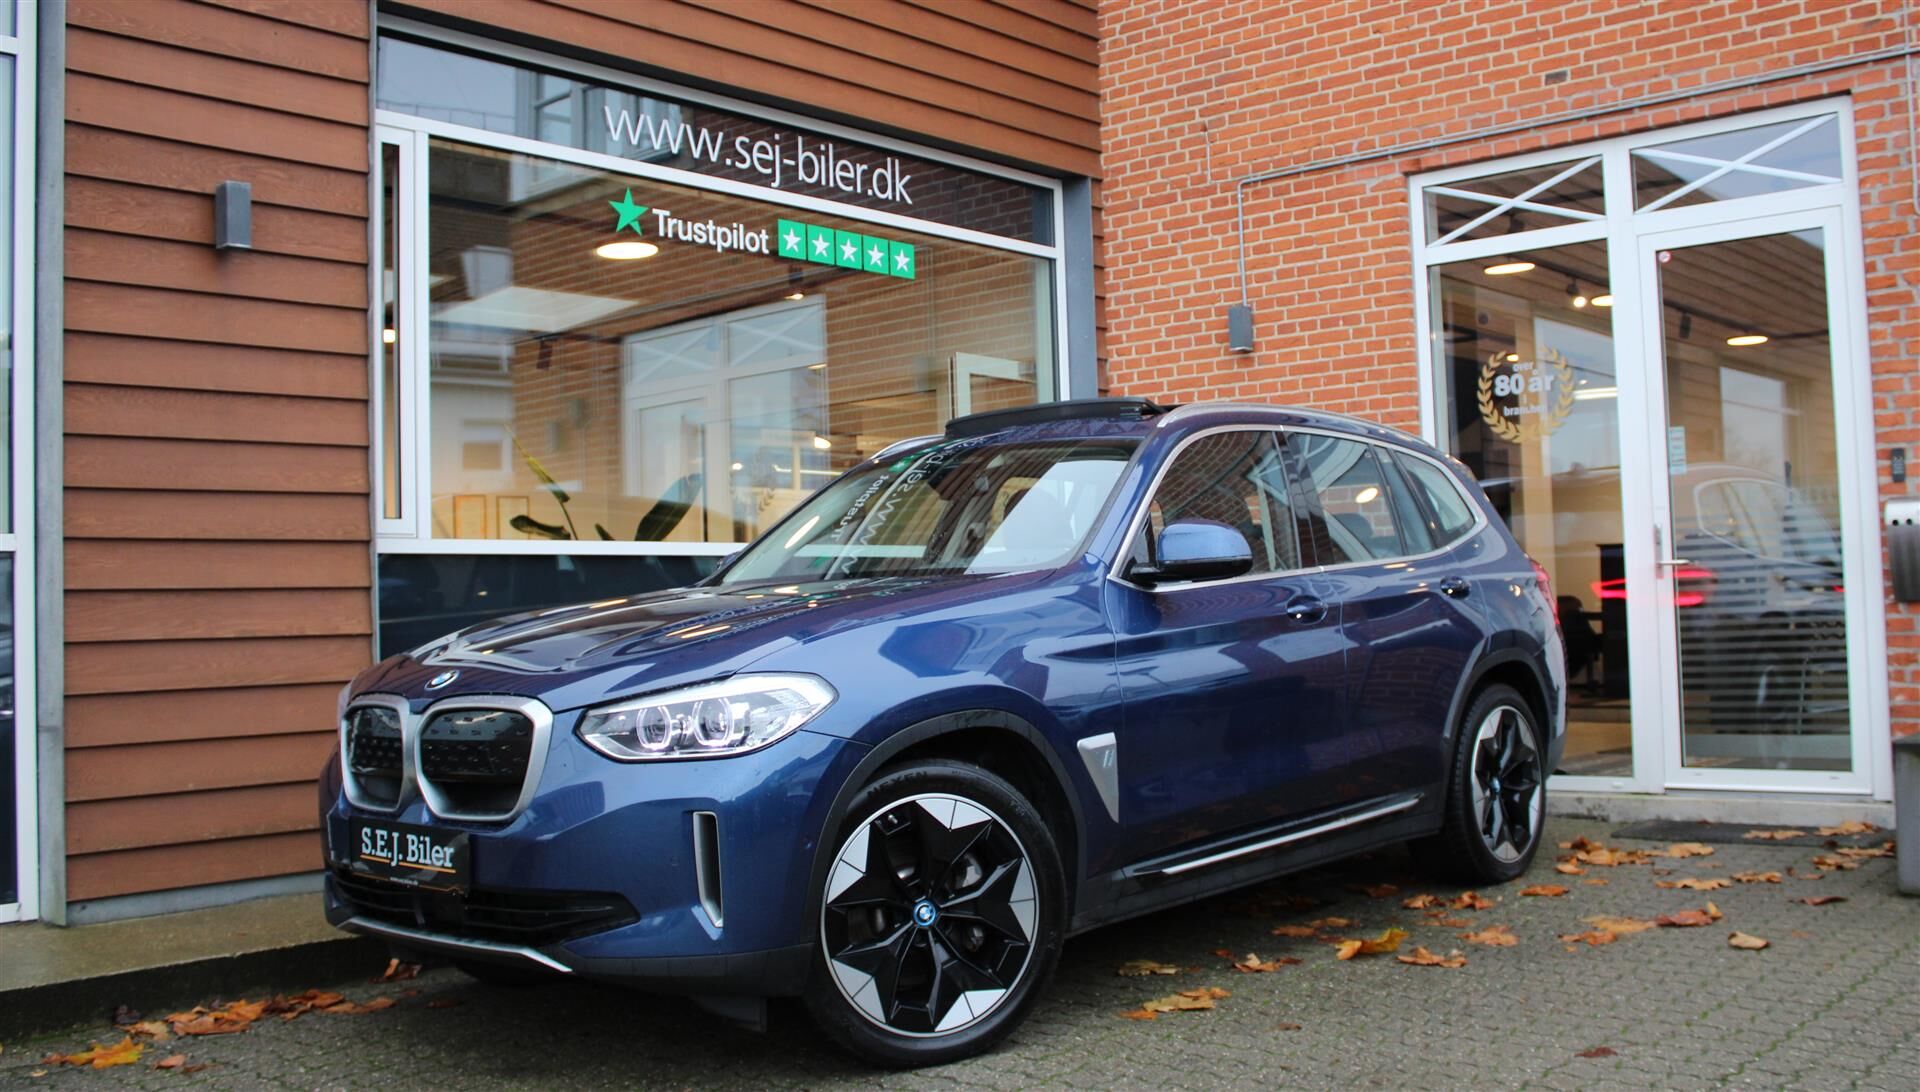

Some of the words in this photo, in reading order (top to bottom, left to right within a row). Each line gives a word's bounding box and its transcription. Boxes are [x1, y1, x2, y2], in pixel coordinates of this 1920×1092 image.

[604, 105, 913, 205] www.sej-biler.dk
[652, 208, 769, 254] Trustpilot
[1494, 373, 1524, 397] 80
[1528, 369, 1554, 392] år
[361, 826, 403, 867] S.E.J.
[406, 833, 455, 868] Biler
